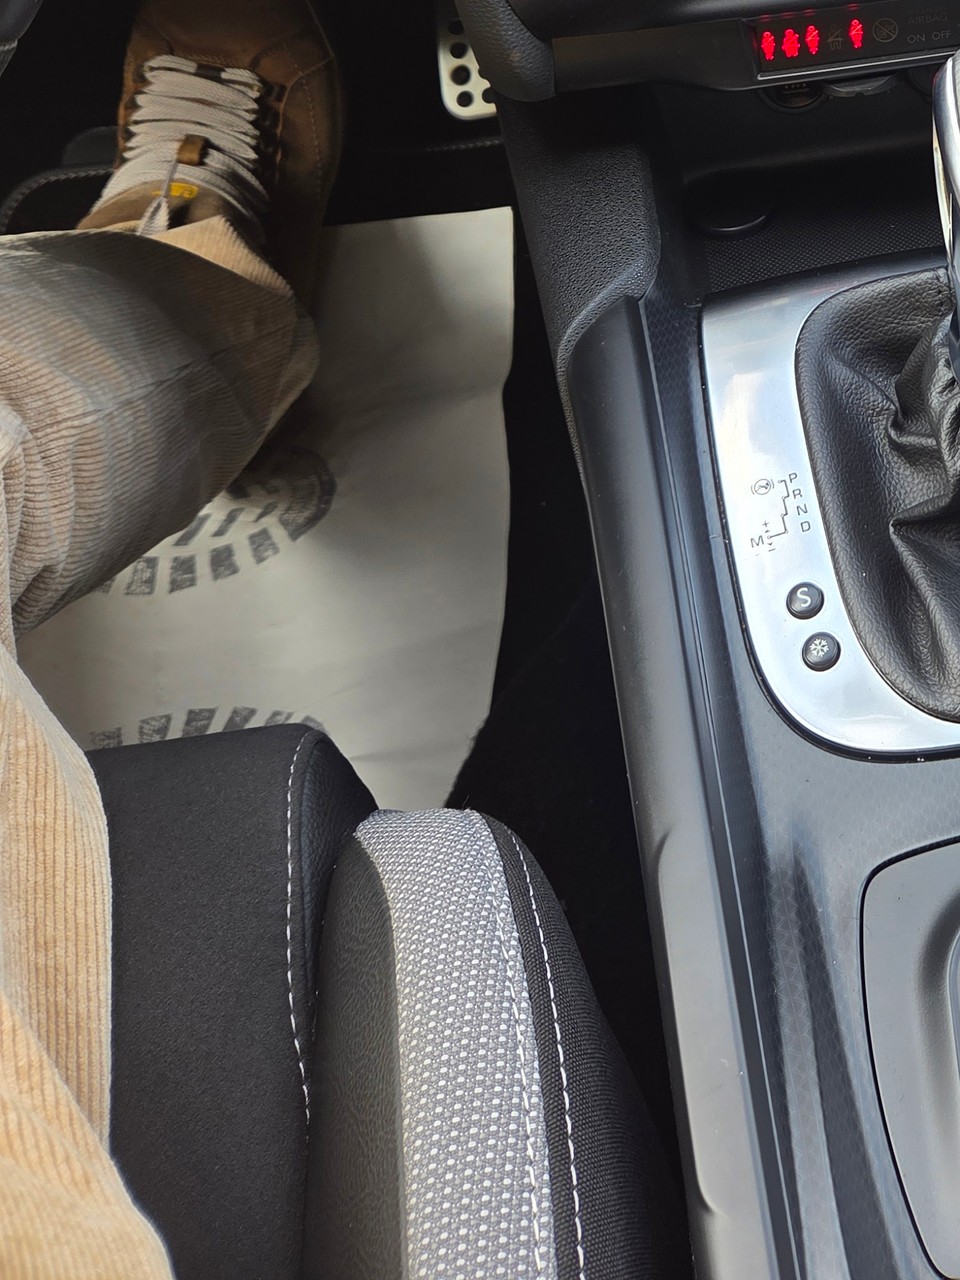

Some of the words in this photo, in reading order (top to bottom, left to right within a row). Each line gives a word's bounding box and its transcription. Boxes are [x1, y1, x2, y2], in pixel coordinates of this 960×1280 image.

[907, 14, 949, 25] AIRBAG
[907, 33, 926, 44] ON
[931, 31, 951, 41] OFF
[788, 473, 798, 484] P
[792, 489, 803, 500] R
[796, 504, 808, 516] N
[800, 521, 811, 533] D
[750, 535, 765, 548] M
[796, 587, 812, 607] S
